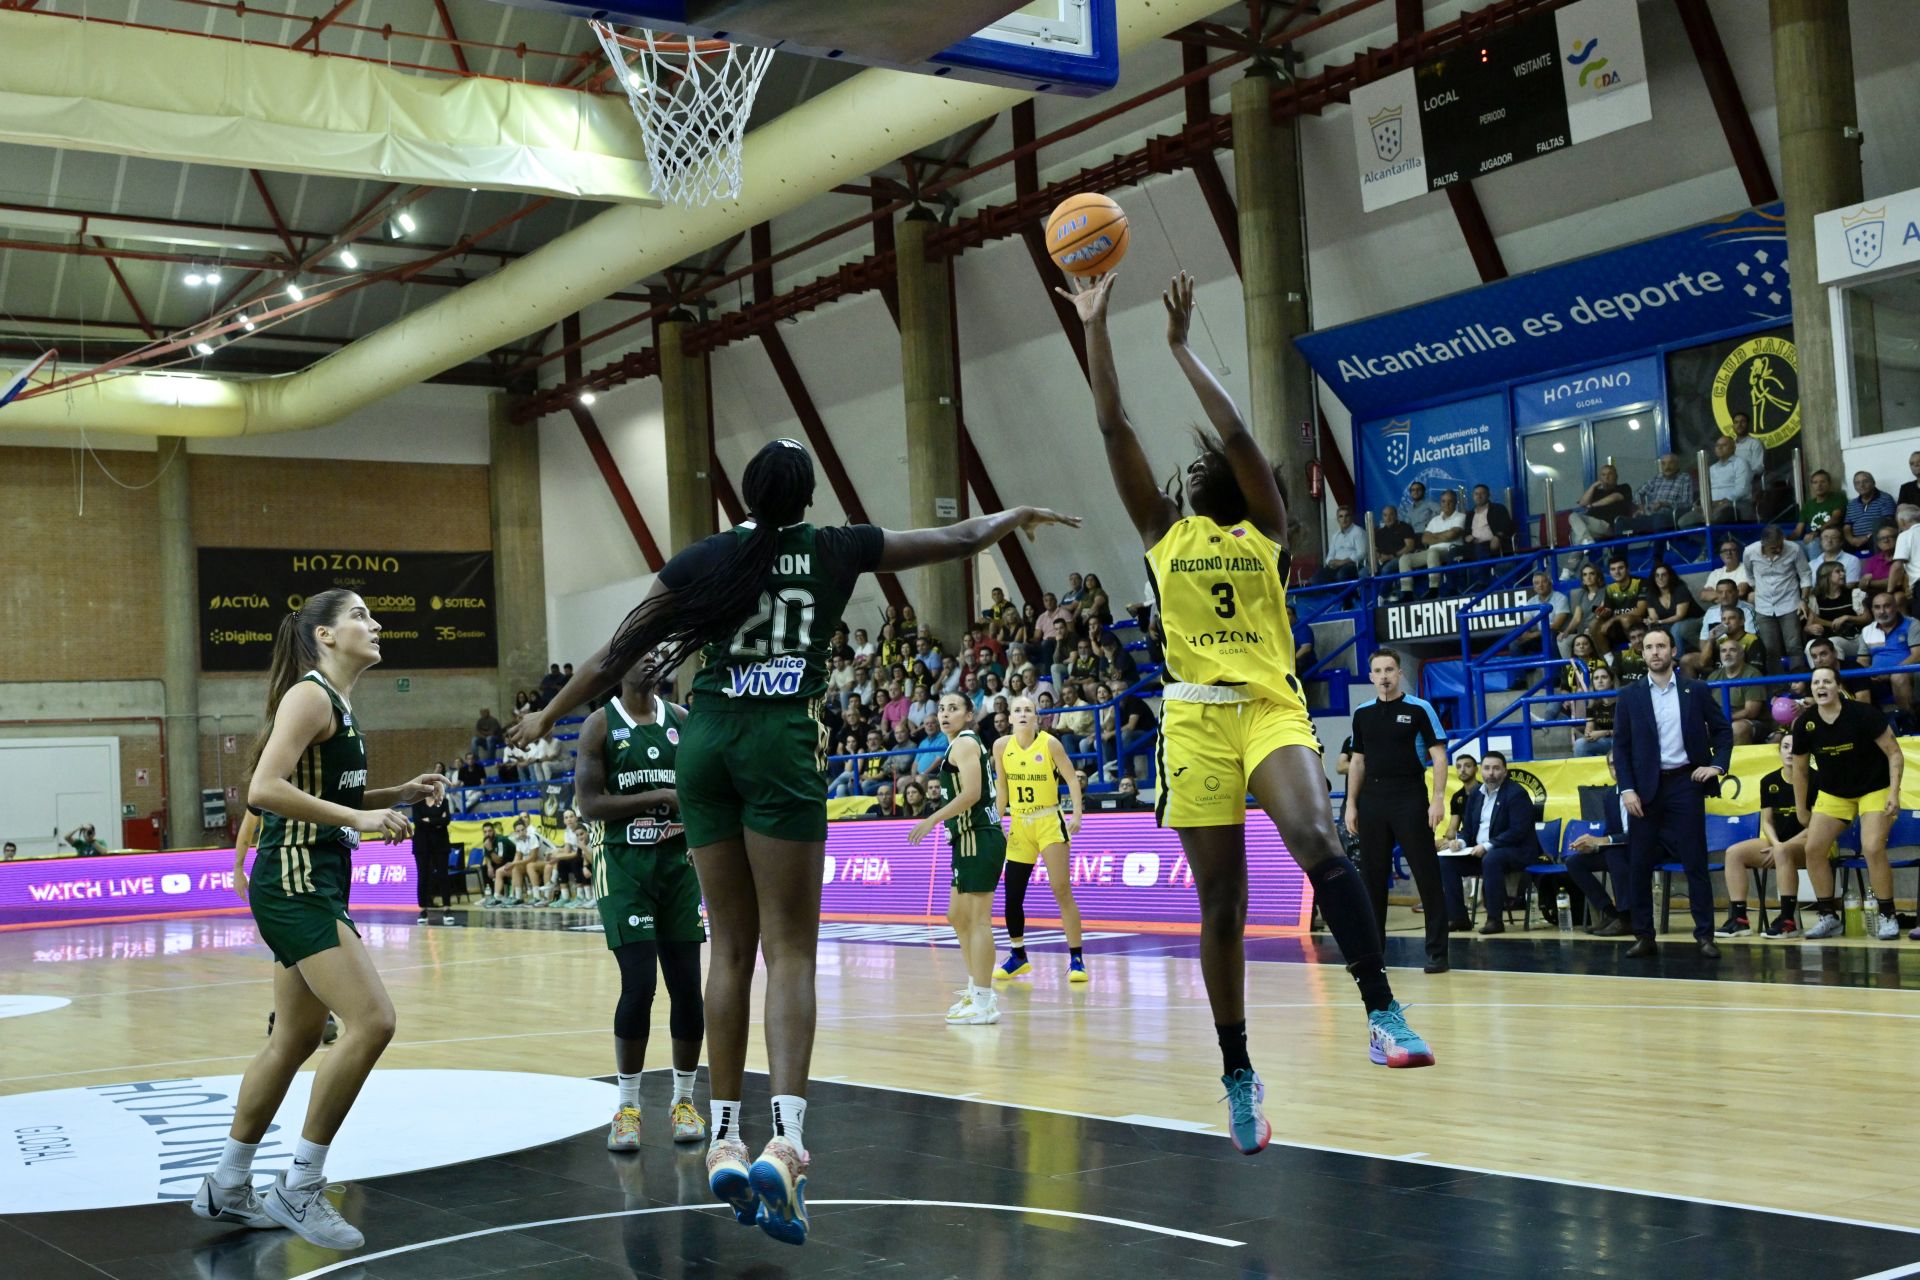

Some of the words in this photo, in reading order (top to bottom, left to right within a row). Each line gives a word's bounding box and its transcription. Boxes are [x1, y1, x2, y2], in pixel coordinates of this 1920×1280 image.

[1513, 53, 1552, 77] VISITANTE
[1424, 89, 1460, 111] LOCAL
[1480, 108, 1506, 125] PERIODO
[1536, 135, 1565, 153] FALTAS
[1364, 157, 1422, 185] Alcantarilla
[1480, 153, 1513, 172] JUGADOR
[1433, 171, 1459, 188] FALTAS
[1337, 322, 1516, 384] Alcantarilla
[1522, 310, 1563, 338] es
[1569, 267, 1725, 321] deporte
[1543, 371, 1631, 404] HOZONO
[1575, 397, 1604, 409] GLOBAL
[1428, 427, 1478, 445] Ayuntamiento
[1479, 424, 1490, 433] de
[1412, 437, 1491, 465] Alcantarilla
[293, 554, 399, 573] HOZONO
[1171, 556, 1222, 573] HOZONO
[222, 594, 270, 609] ACTÚA
[444, 598, 486, 608] SOTECA
[1211, 582, 1236, 619] 3
[730, 587, 815, 656] 20
[766, 657, 804, 669] Juice
[728, 663, 801, 695] Viva
[1017, 786, 1035, 803] 13
[28, 881, 101, 901] WATCH
[109, 876, 155, 897] LIVE
